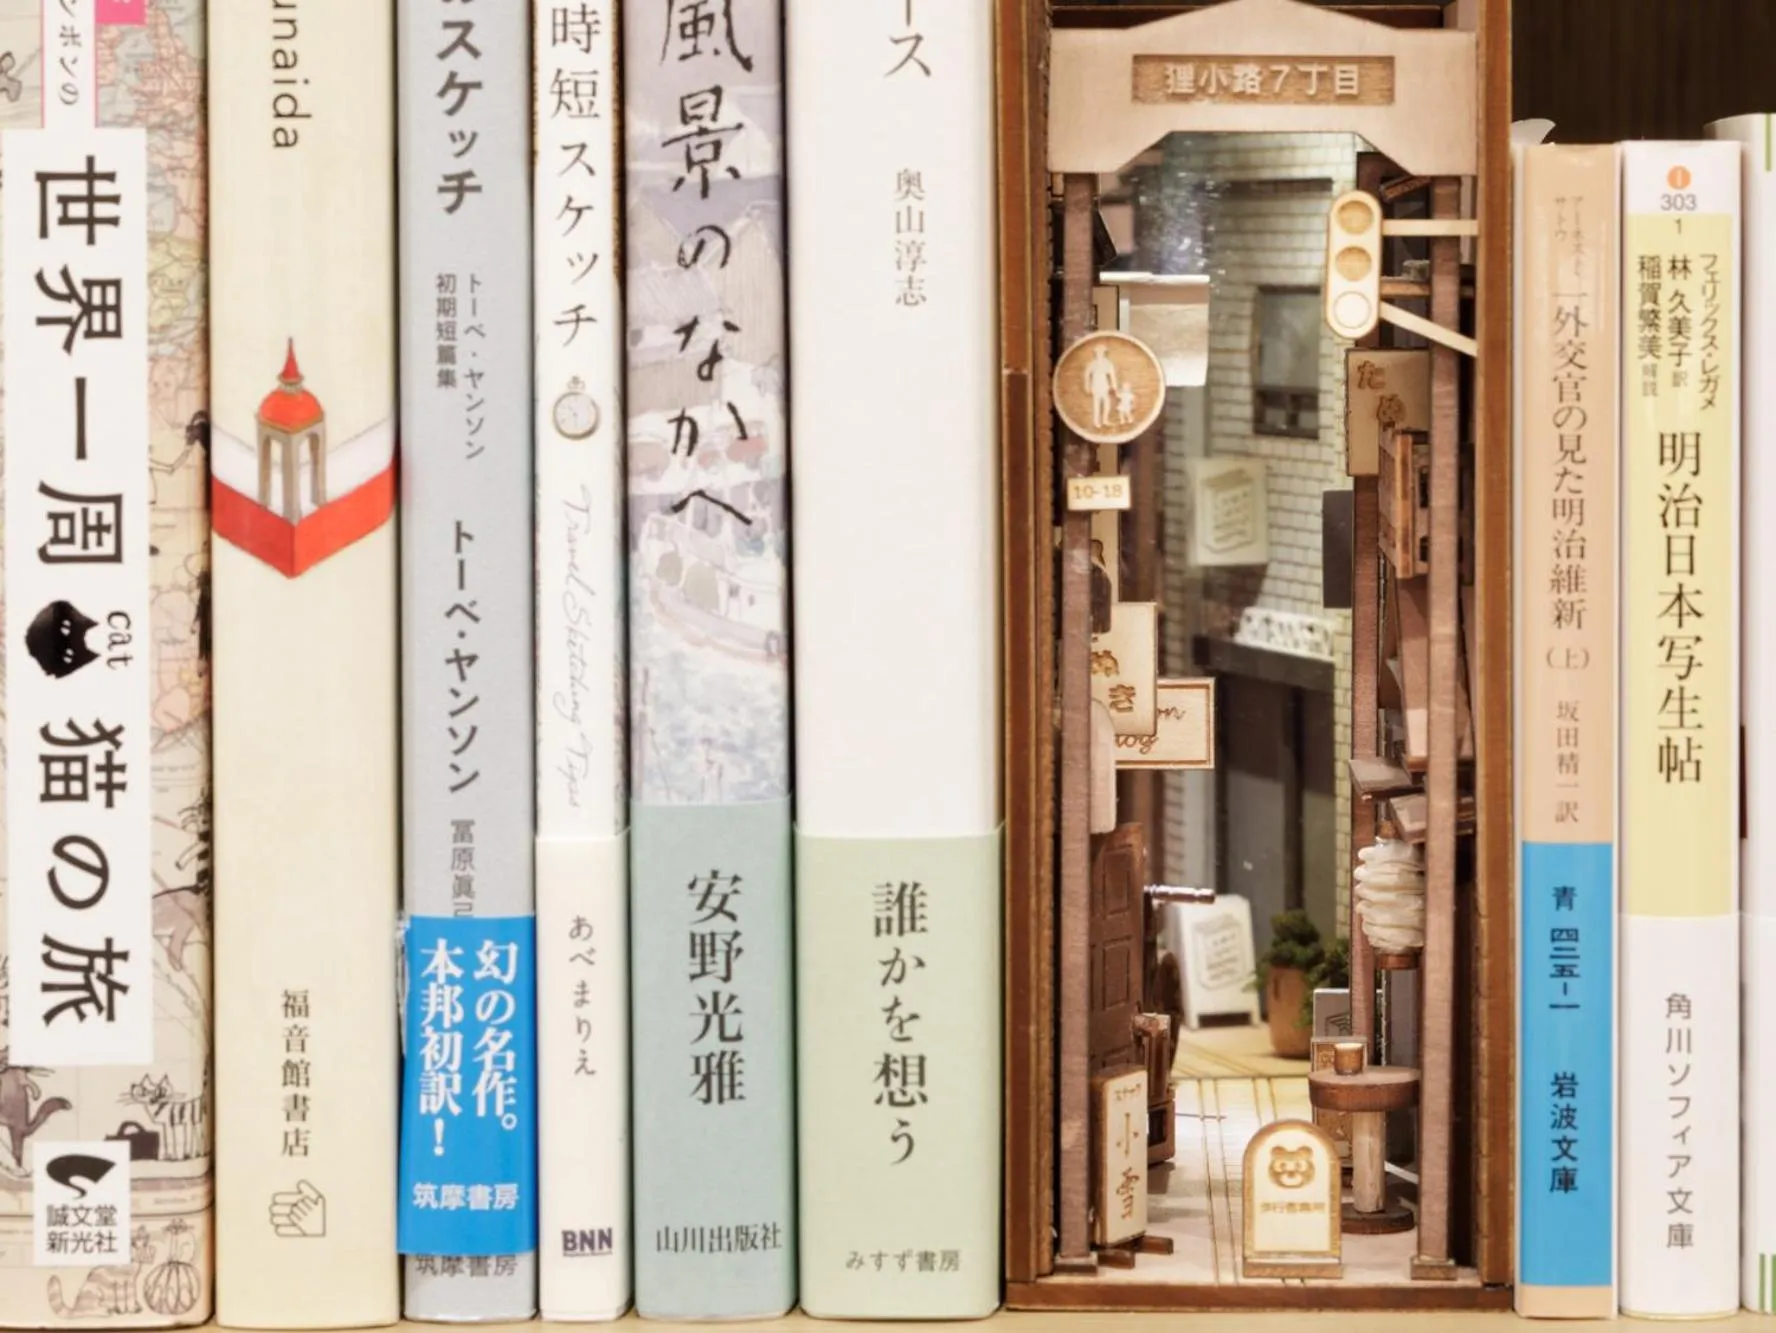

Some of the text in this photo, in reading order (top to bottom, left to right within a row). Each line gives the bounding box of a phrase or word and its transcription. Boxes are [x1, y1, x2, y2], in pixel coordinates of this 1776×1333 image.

[436, 0, 483, 215] スケッチ
[1164, 62, 1361, 97] 狸小路7丁目
[549, 2, 601, 349] 時短スケッチ
[894, 168, 928, 307] 奥山淳志
[1660, 192, 1698, 211] 303
[1674, 218, 1683, 235] 1
[436, 273, 458, 389] 初期短篇集
[660, 0, 754, 526] 風景のなかへ
[1699, 253, 1721, 411] フェリックス・レガメ
[464, 273, 487, 460] トーベ・ヤンソン
[1074, 484, 1123, 499] 10-18
[1549, 291, 1589, 632] 一外交官の見た明治維新
[34, 154, 130, 1028] 世界一周 猫の旅
[105, 610, 134, 670] cat
[444, 520, 481, 794] トーベ・ヤンソン
[1657, 431, 1704, 785] 明治日本写生帖
[1552, 886, 1577, 911] 青
[473, 939, 519, 1131] 幻の名作。
[567, 914, 597, 1077] あべまりえ
[687, 869, 746, 1105] 安野光雅
[872, 881, 929, 1165] 誰かを想う
[281, 989, 311, 1158] 福音館書店
[1550, 1072, 1579, 1193] 岩波文庫
[1665, 992, 1694, 1250] 角川ソフィア文庫
[46, 1203, 118, 1228] 誠文堂
[46, 1230, 118, 1254] 新光社
[412, 1182, 519, 1211] 筑摩書房
[561, 1228, 613, 1252] BNN
[656, 1221, 783, 1255] 山川出版社
[845, 1249, 962, 1273] みすず書房
